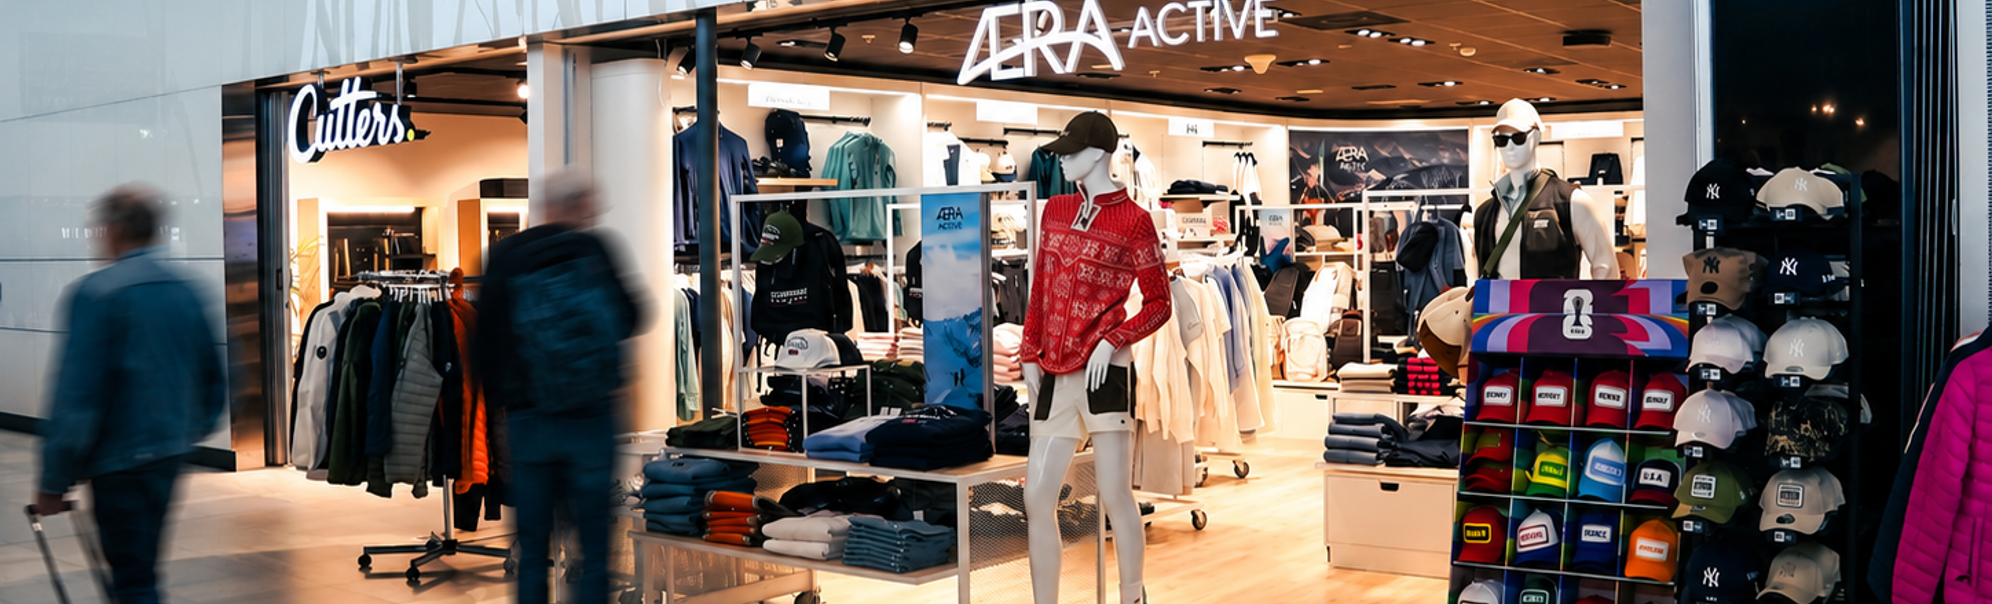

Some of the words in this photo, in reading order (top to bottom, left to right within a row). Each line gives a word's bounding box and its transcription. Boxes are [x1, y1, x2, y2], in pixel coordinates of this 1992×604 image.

[1128, 0, 1279, 48] ACTIVE
[1706, 183, 1720, 199] NY
[1703, 256, 1720, 274] NY
[1779, 257, 1799, 276] NY
[1702, 566, 1720, 587] NY
